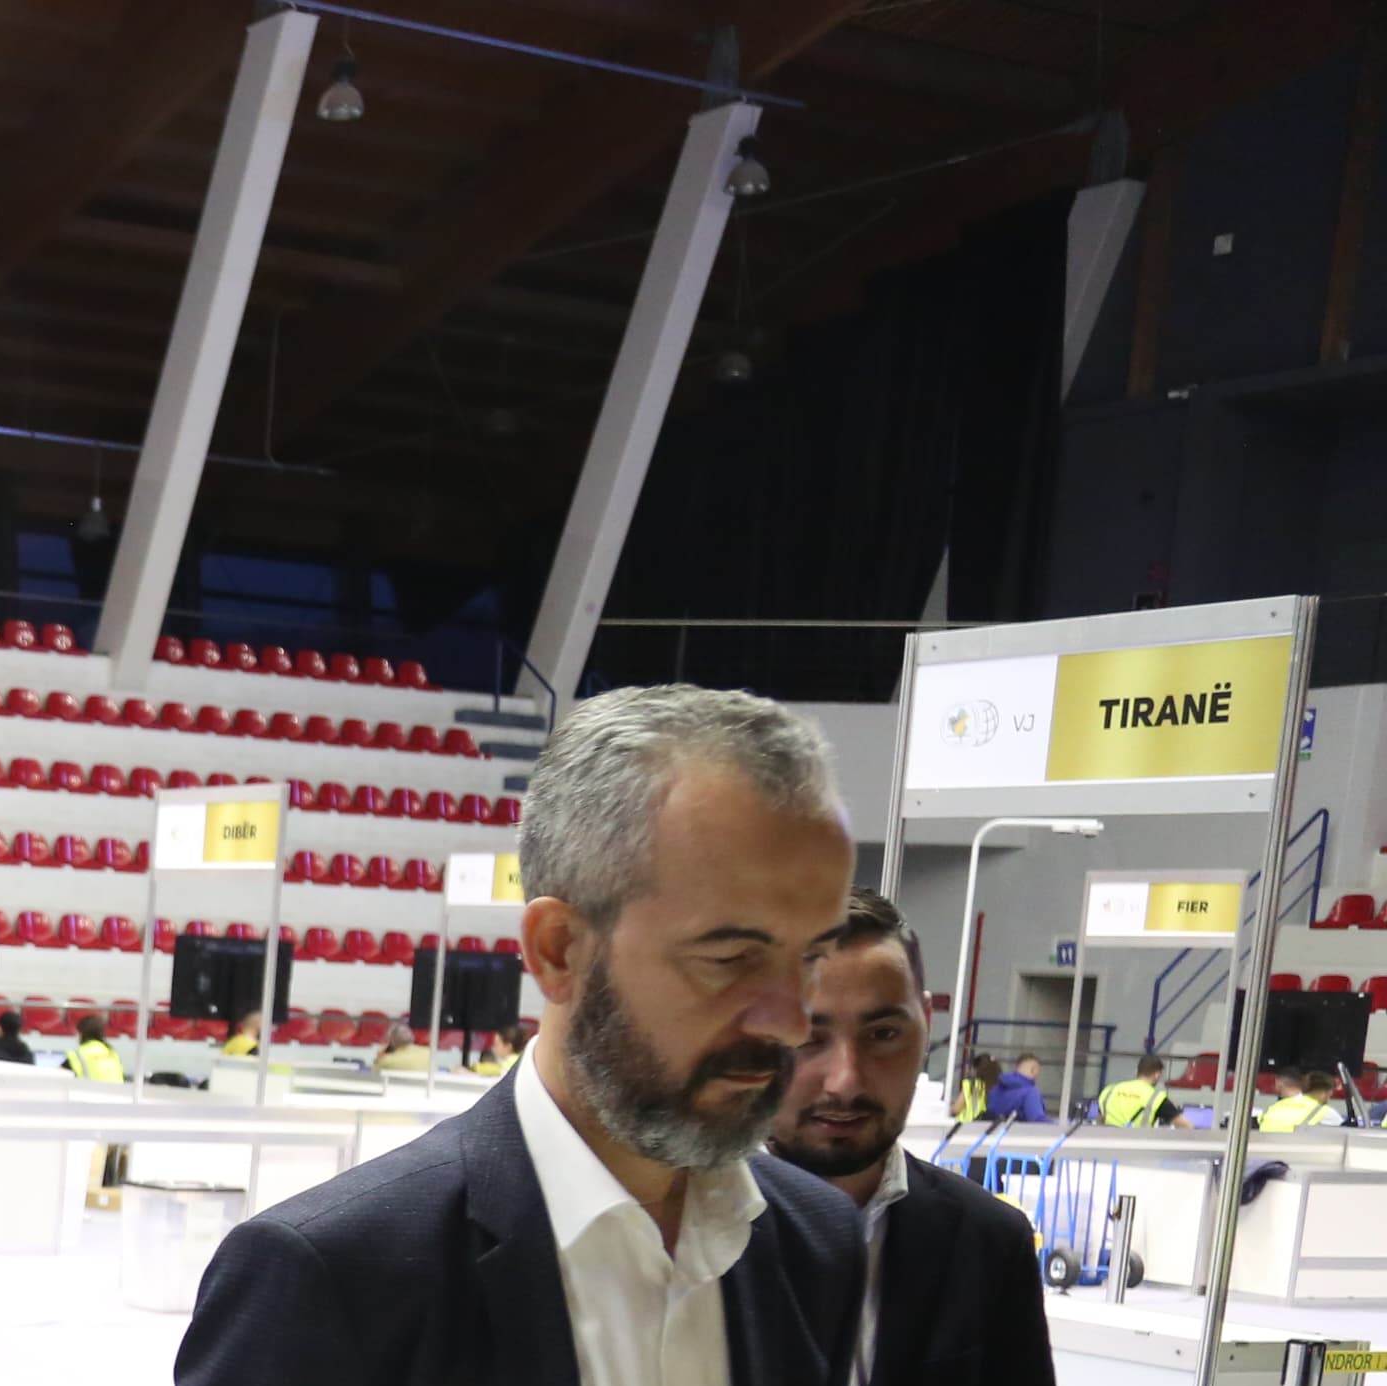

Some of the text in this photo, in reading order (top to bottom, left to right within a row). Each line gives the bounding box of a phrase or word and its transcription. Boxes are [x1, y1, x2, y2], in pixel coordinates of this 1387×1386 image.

[1098, 681, 1233, 730] TIRANË
[1012, 713, 1035, 733] VJ
[221, 823, 258, 841] DIBËR
[1176, 899, 1209, 914] FIER
